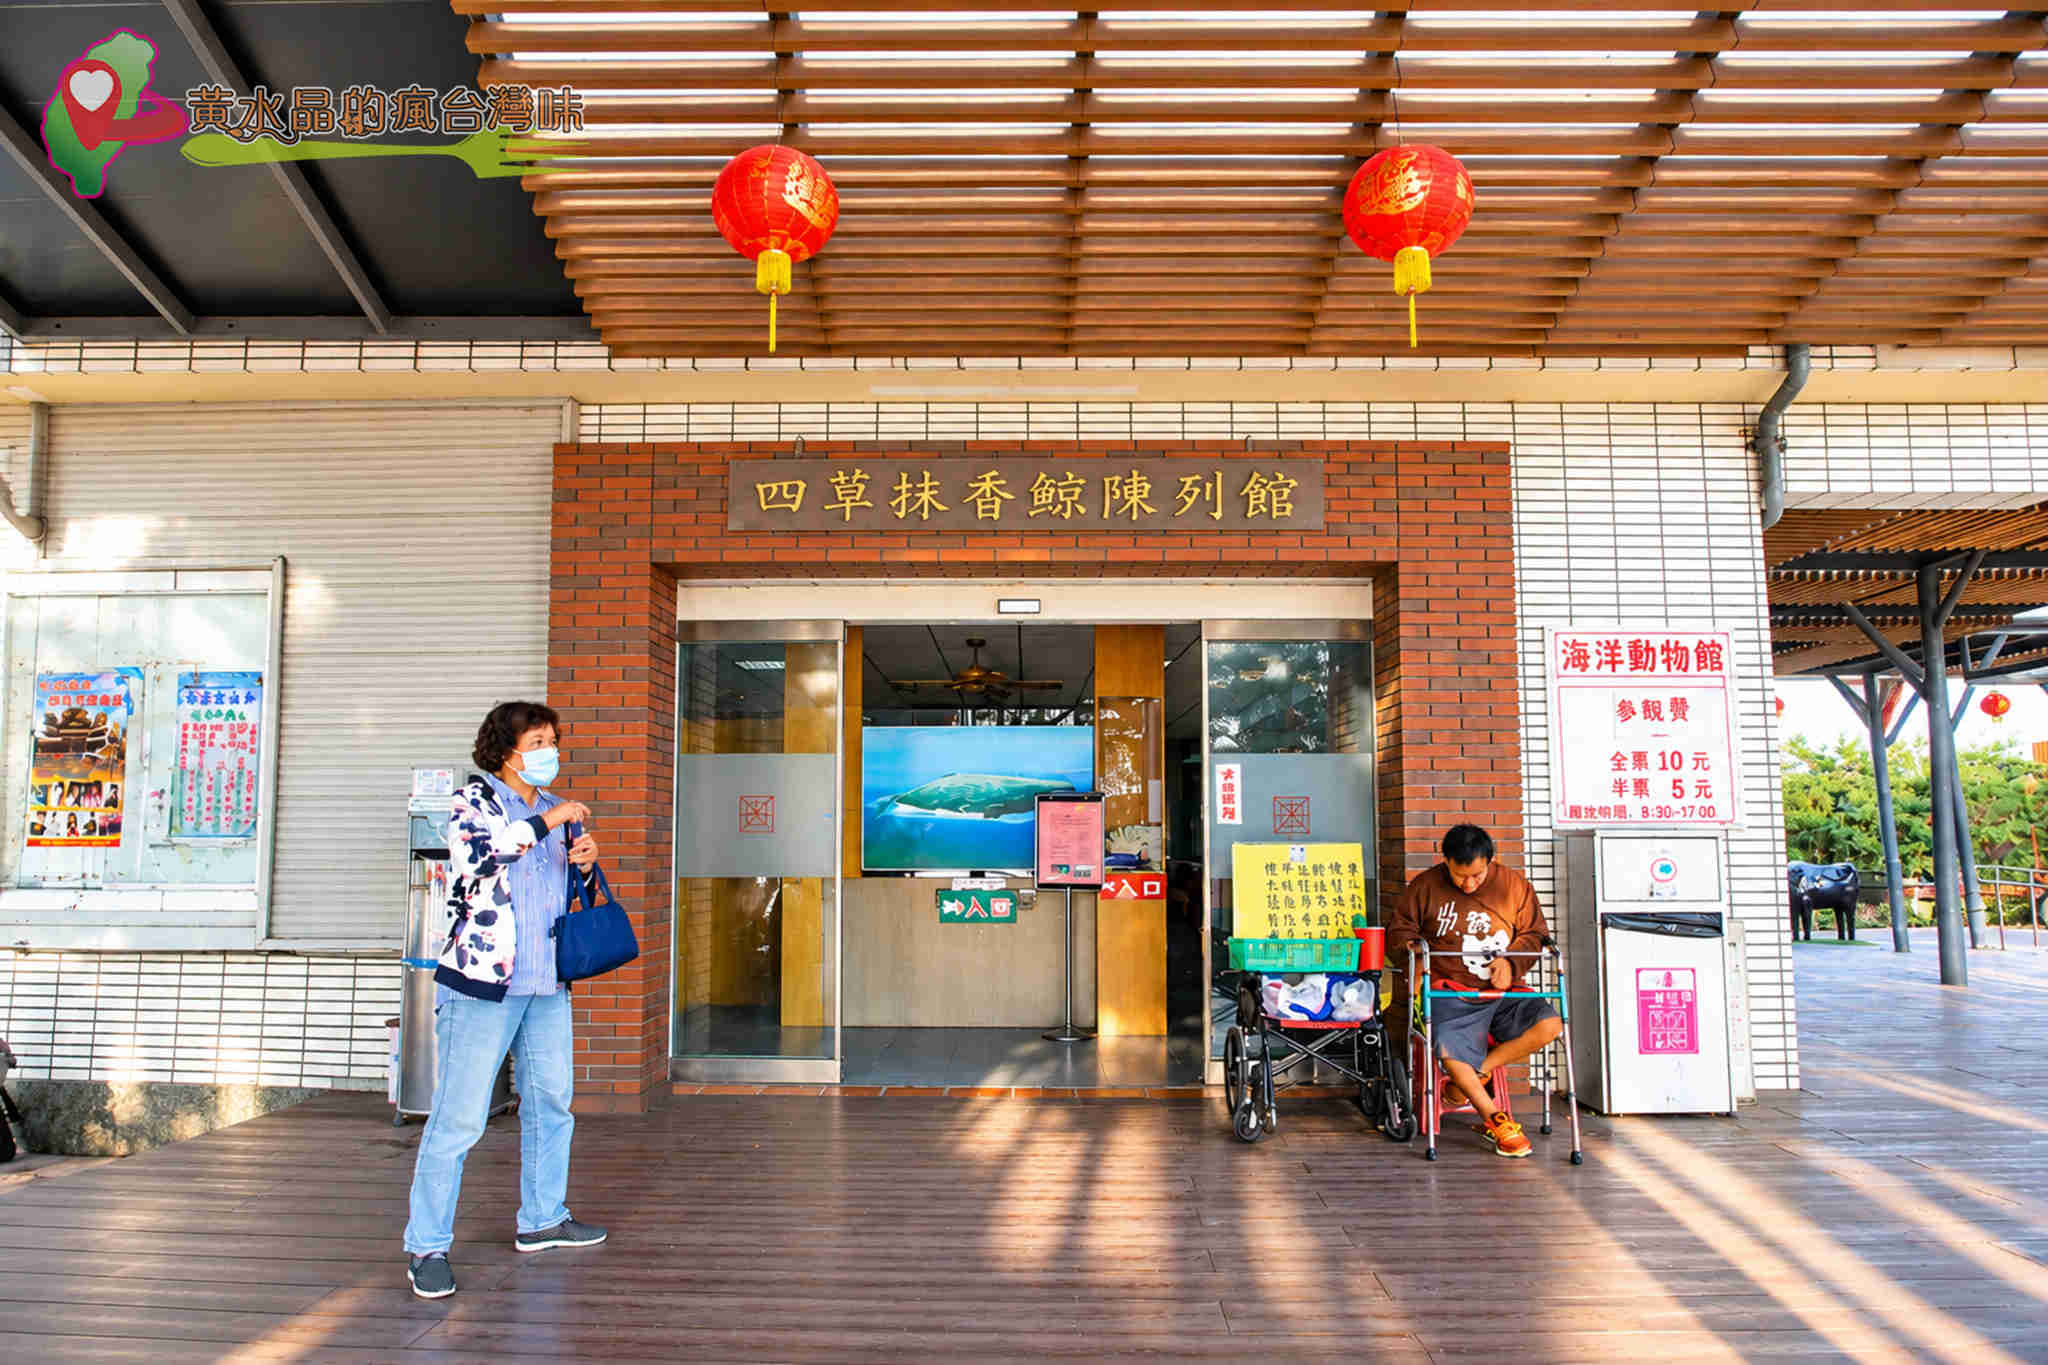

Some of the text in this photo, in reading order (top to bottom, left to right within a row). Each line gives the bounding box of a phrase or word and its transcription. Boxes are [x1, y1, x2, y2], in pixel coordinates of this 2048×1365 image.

[755, 468, 1299, 522] 四草抹香鯨陳列館
[1561, 637, 1724, 673] 海洋動物館
[1616, 696, 1690, 724] 參觀費
[1609, 750, 1711, 772] 全票 10 元
[1612, 777, 1713, 800] 半票 5 元
[1116, 879, 1161, 897] 入口
[964, 895, 1011, 918] 入口
